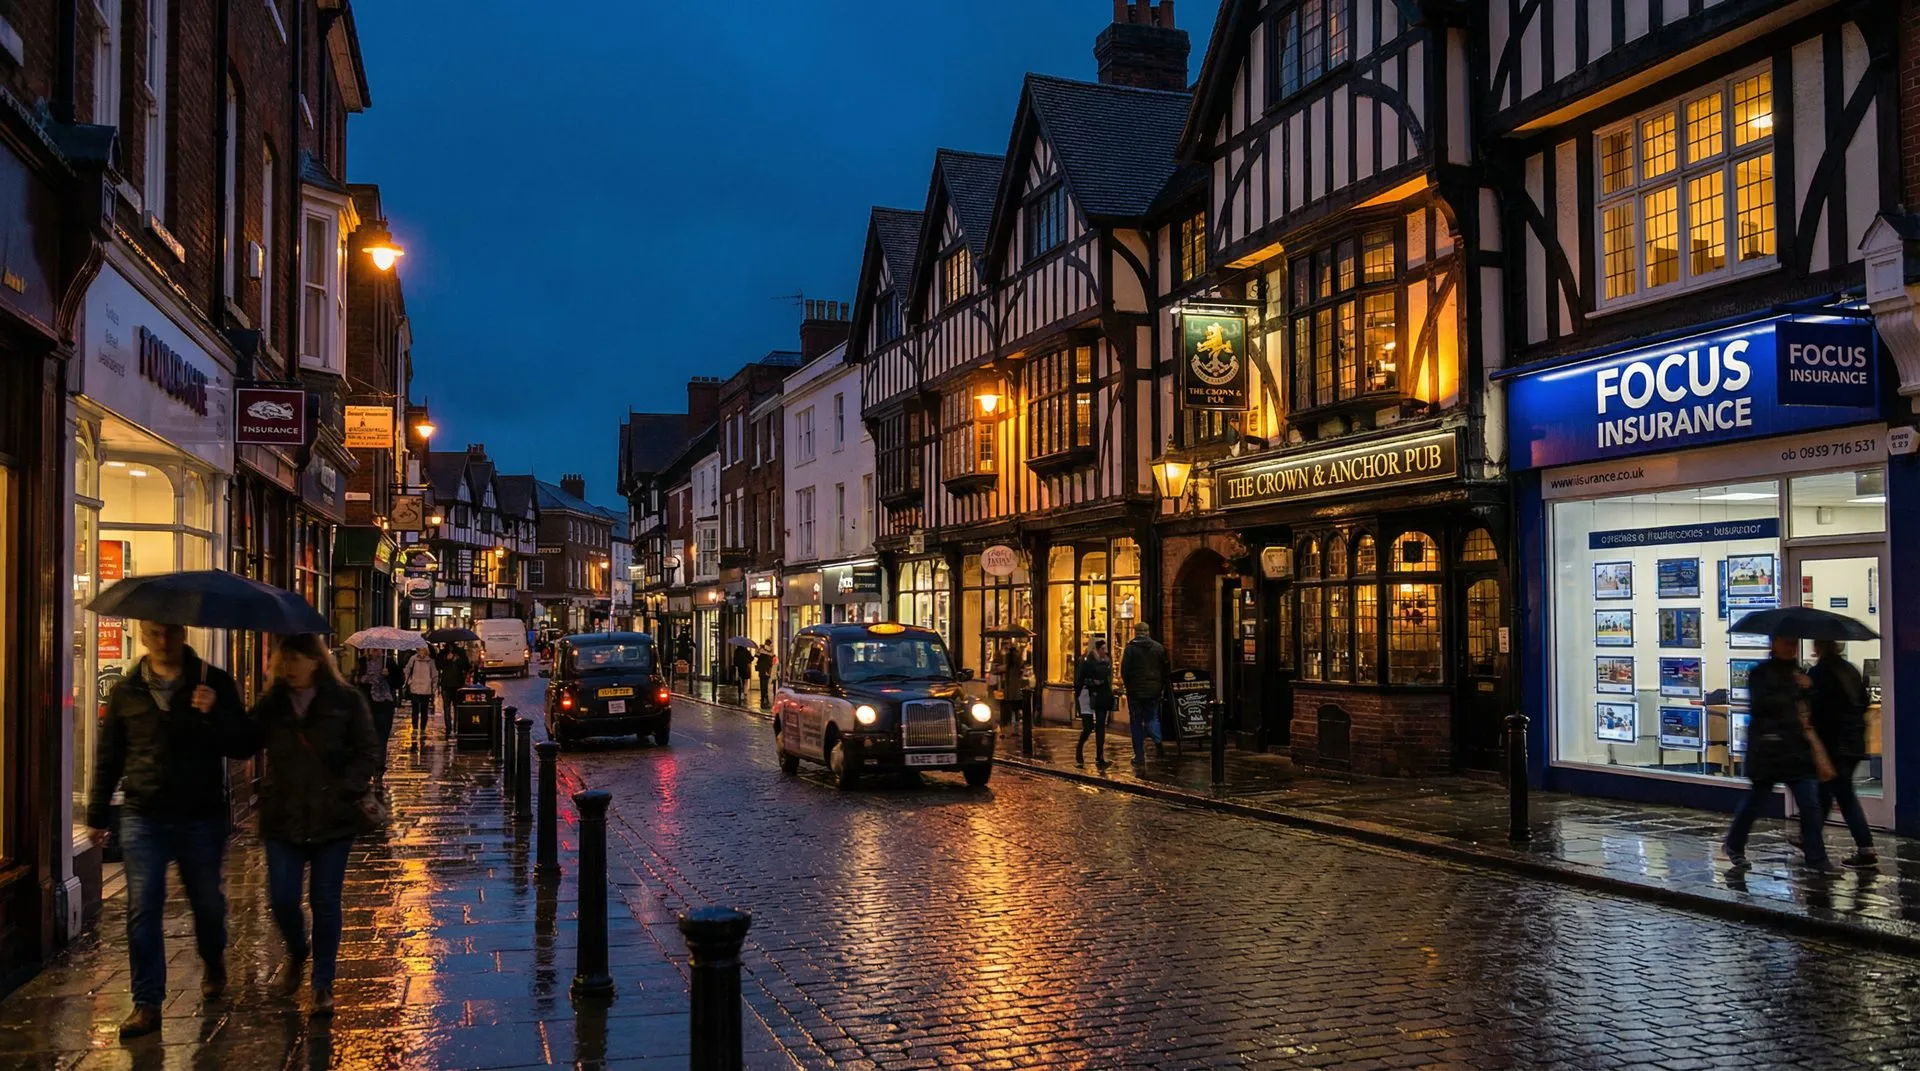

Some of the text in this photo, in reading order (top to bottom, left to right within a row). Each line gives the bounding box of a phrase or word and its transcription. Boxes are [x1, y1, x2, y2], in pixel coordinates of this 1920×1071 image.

[1789, 344, 1867, 367] FOCUS
[1597, 339, 1751, 413] FOCUS
[1789, 370, 1868, 385] INSURANCE
[1597, 397, 1752, 448] INSURANCE
[1832, 442, 1852, 455] 716
[1854, 439, 1875, 453] 531
[1228, 445, 1442, 499] THE CROWN & ANCHOR PUB
